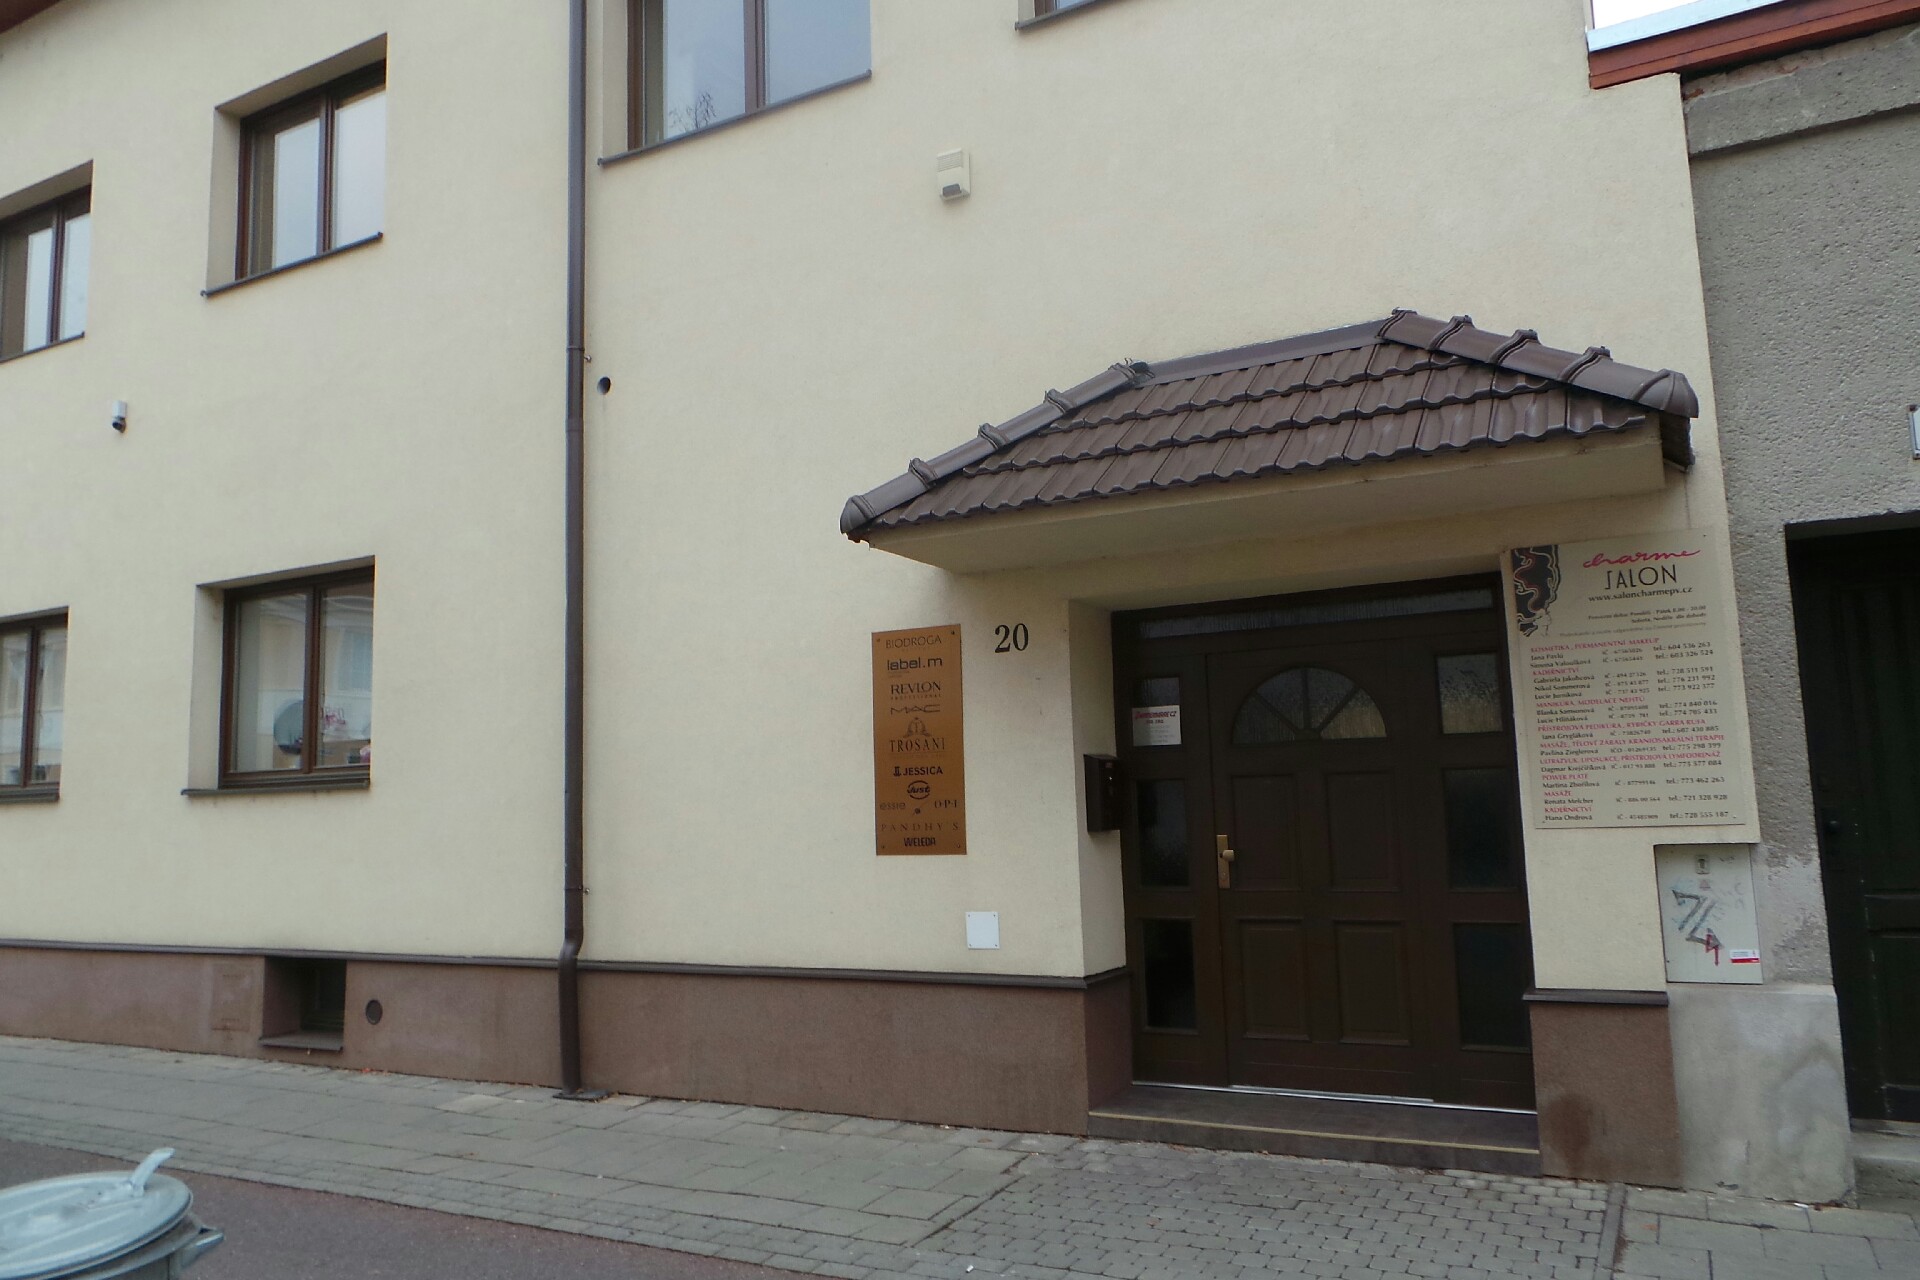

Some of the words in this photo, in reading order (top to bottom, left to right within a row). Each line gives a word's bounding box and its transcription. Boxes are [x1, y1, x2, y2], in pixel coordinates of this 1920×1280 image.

[1605, 564, 1677, 589] SALON
[886, 634, 942, 649] BIODROGA
[994, 623, 1028, 653] 20
[887, 656, 942, 670] label.m
[891, 681, 941, 695] REVLON
[890, 737, 945, 752] TROSANI
[903, 766, 944, 776] JESSICA
[879, 802, 906, 810] essie
[904, 837, 936, 847] WELEDA
